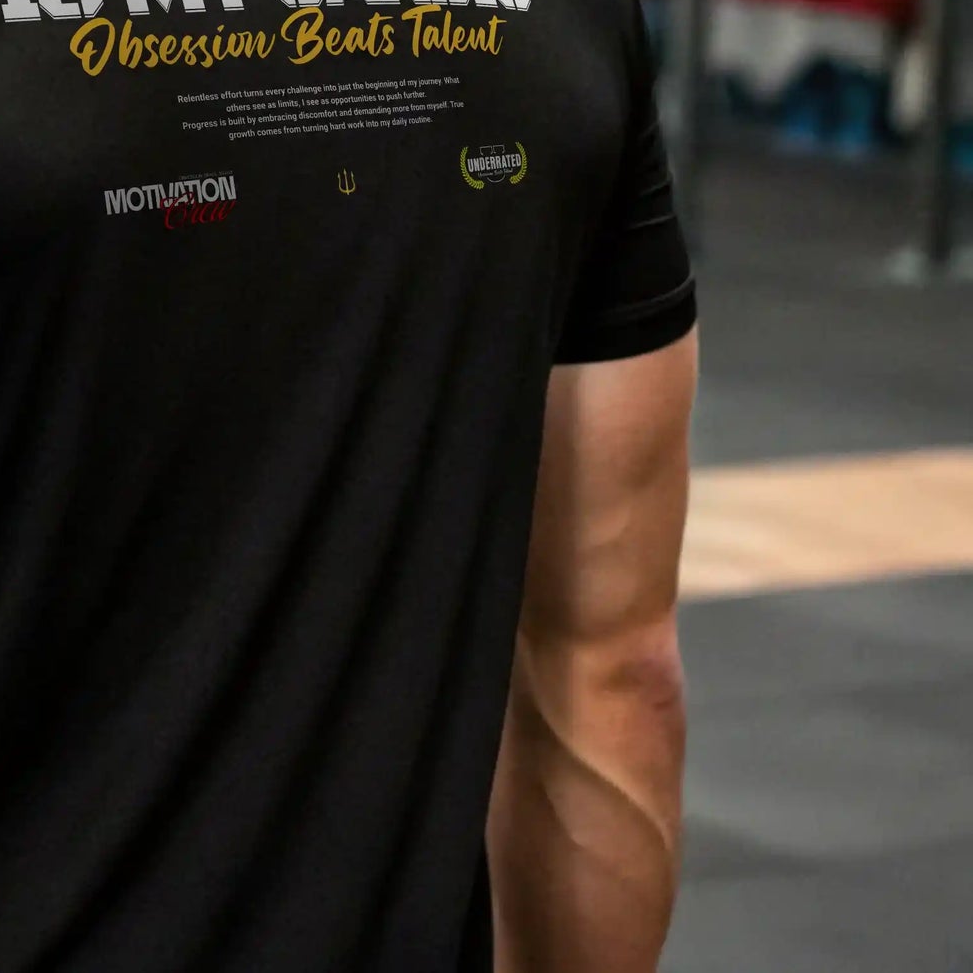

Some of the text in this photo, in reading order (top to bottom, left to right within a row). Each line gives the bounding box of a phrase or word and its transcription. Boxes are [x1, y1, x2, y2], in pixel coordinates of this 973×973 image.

[70, 4, 507, 76] Obsession Beats Talent
[177, 93, 219, 103] Relentless
[221, 91, 242, 100] effort
[243, 90, 263, 98] turns
[287, 86, 322, 94] challenge
[323, 84, 337, 92] into
[338, 83, 352, 92] just
[352, 82, 365, 90] the
[365, 80, 399, 90] beginning
[399, 79, 406, 87] of
[407, 80, 417, 88] my
[226, 103, 251, 112] others
[278, 100, 301, 108] limits,
[330, 94, 377, 105] opportunities
[386, 92, 403, 102] push
[403, 91, 427, 100] further.
[182, 121, 218, 130] Progress
[228, 117, 246, 126] built
[247, 116, 256, 125] by
[258, 113, 297, 122] embracing
[298, 109, 338, 120] discomfort
[339, 108, 352, 117] and
[353, 106, 392, 115] demanding
[392, 105, 410, 113] more
[449, 100, 465, 108] True
[229, 129, 255, 140] growth
[283, 125, 302, 134] from
[303, 124, 329, 133] turning
[330, 122, 346, 130] hard
[347, 120, 365, 129] work
[365, 119, 379, 127] into
[380, 119, 391, 127] my
[391, 117, 408, 127] daily
[408, 115, 433, 124] routine.
[467, 153, 521, 173] UNDERRATED
[104, 175, 237, 216] MOTIVATION
